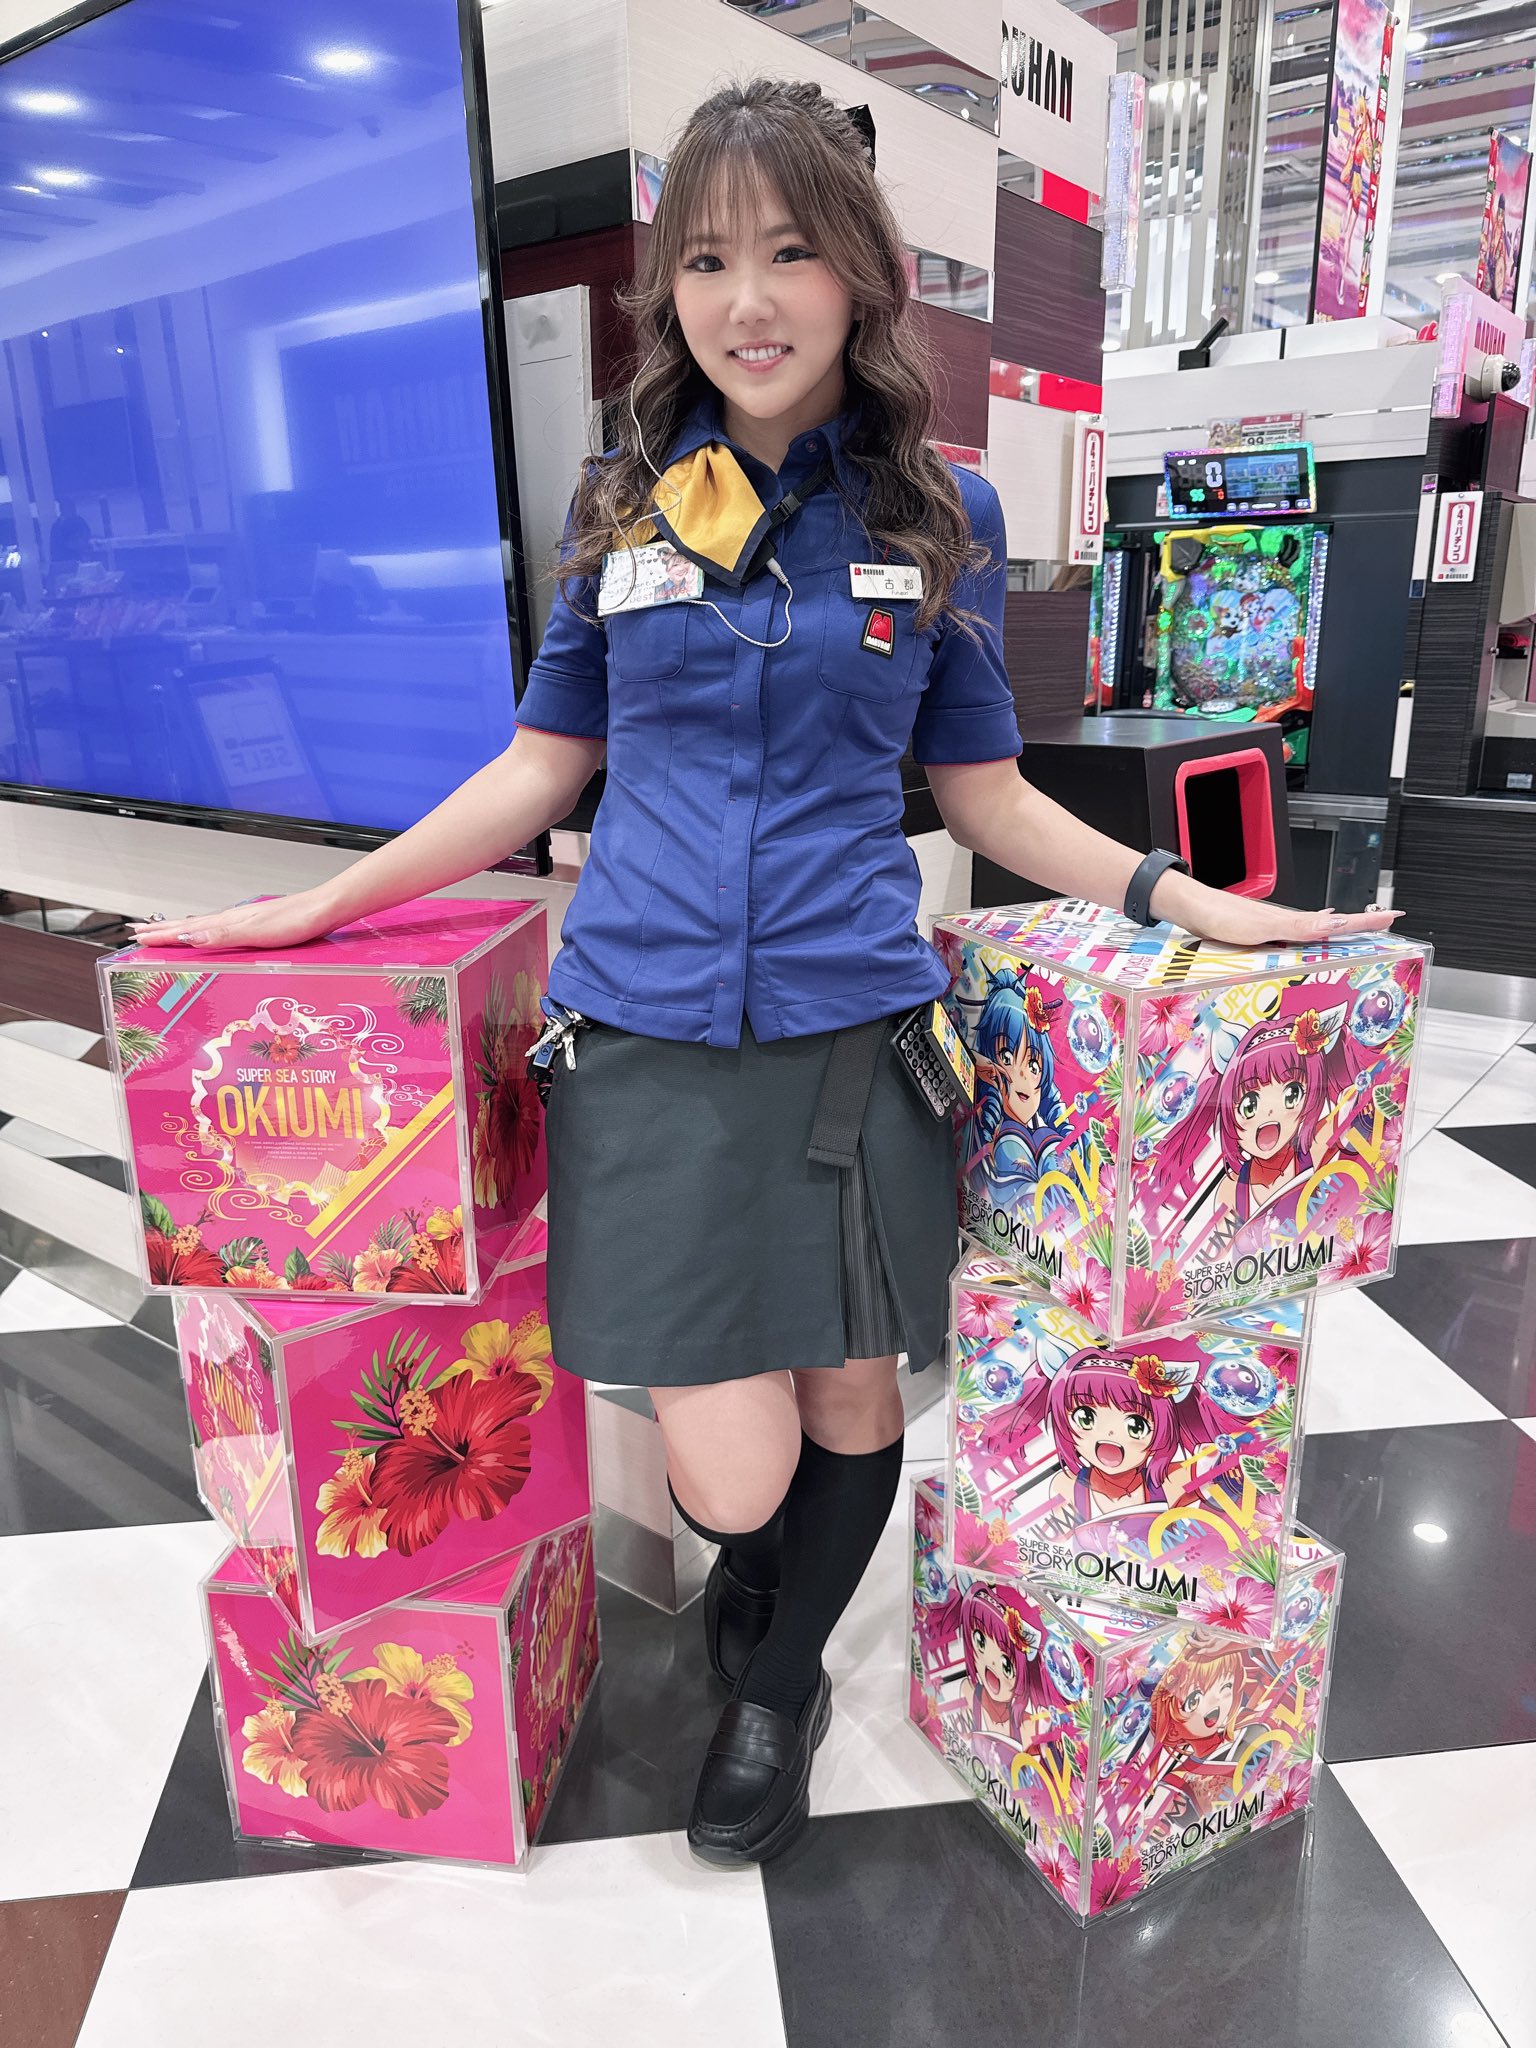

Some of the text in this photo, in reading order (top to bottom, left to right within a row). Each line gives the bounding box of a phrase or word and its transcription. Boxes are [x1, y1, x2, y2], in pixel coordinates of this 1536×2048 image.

[236, 1068, 337, 1084] SUPER SEA STORY
[216, 1085, 365, 1139] OKIUMI
[981, 1198, 993, 1212] SEA
[962, 1196, 993, 1227] STORY
[993, 1208, 1063, 1280] OKIUMI
[1183, 1271, 1233, 1299] STORY
[1233, 1236, 1335, 1286] OKIUMI
[1184, 1261, 1233, 1282] SUPER SEA
[208, 1360, 256, 1435] OKIUMI
[1018, 1547, 1073, 1572] STORY
[1074, 1551, 1198, 1602] OKIUMI
[1019, 1537, 1073, 1558] SUPER SEA
[971, 1755, 1038, 1845] OKIUMI
[1140, 1841, 1181, 1873] STORY
[1181, 1791, 1265, 1848] OKIUMI
[1141, 1832, 1181, 1859] SUPER SEA
